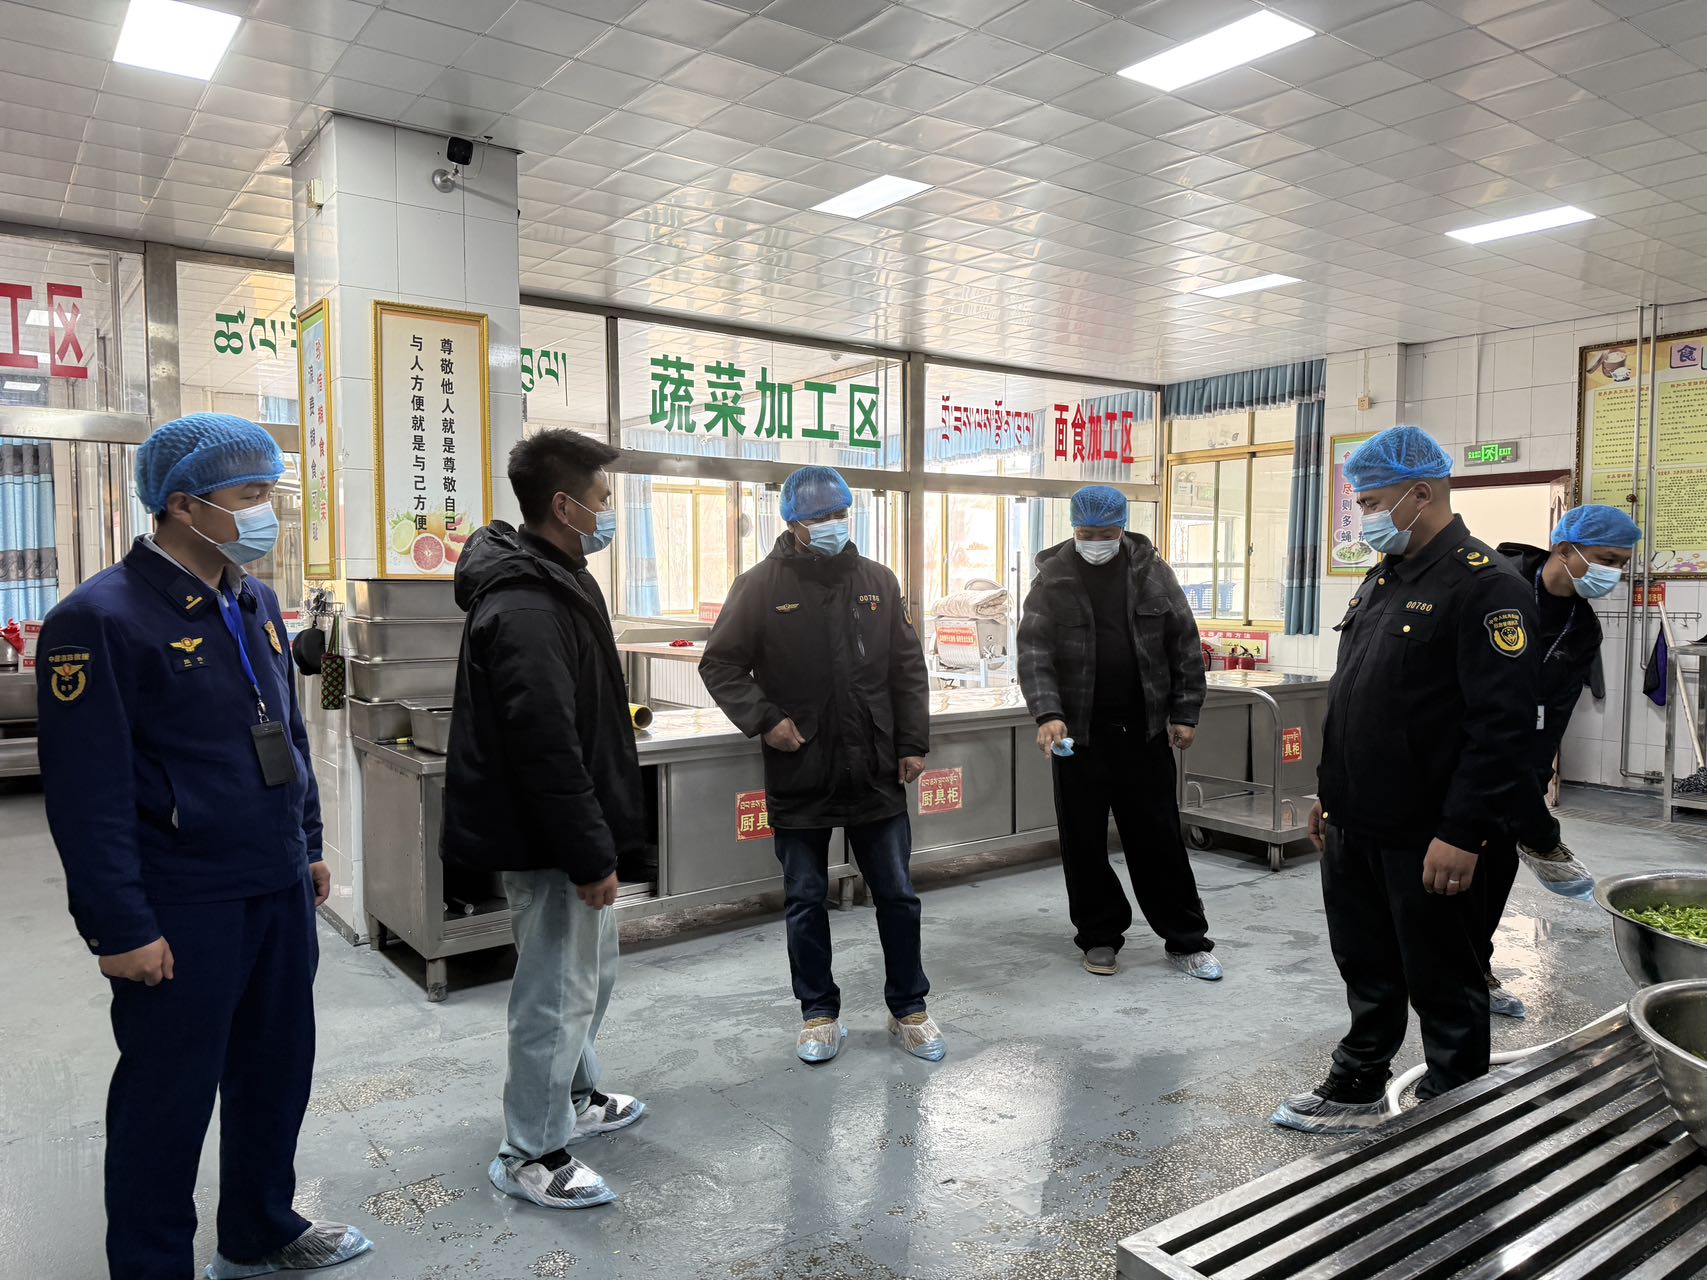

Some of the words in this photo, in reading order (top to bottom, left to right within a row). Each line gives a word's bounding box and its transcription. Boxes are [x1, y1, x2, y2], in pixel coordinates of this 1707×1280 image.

[0, 283, 88, 379] 工区
[410, 335, 427, 531] 与人方便就是与己方便
[440, 338, 457, 531] 尊敬他人就是尊敬自己
[650, 354, 881, 449] 蔬菜加工区
[1054, 403, 1134, 463] 面食加工区
[1406, 601, 1433, 612] 00780
[922, 787, 959, 807] 厨具柜
